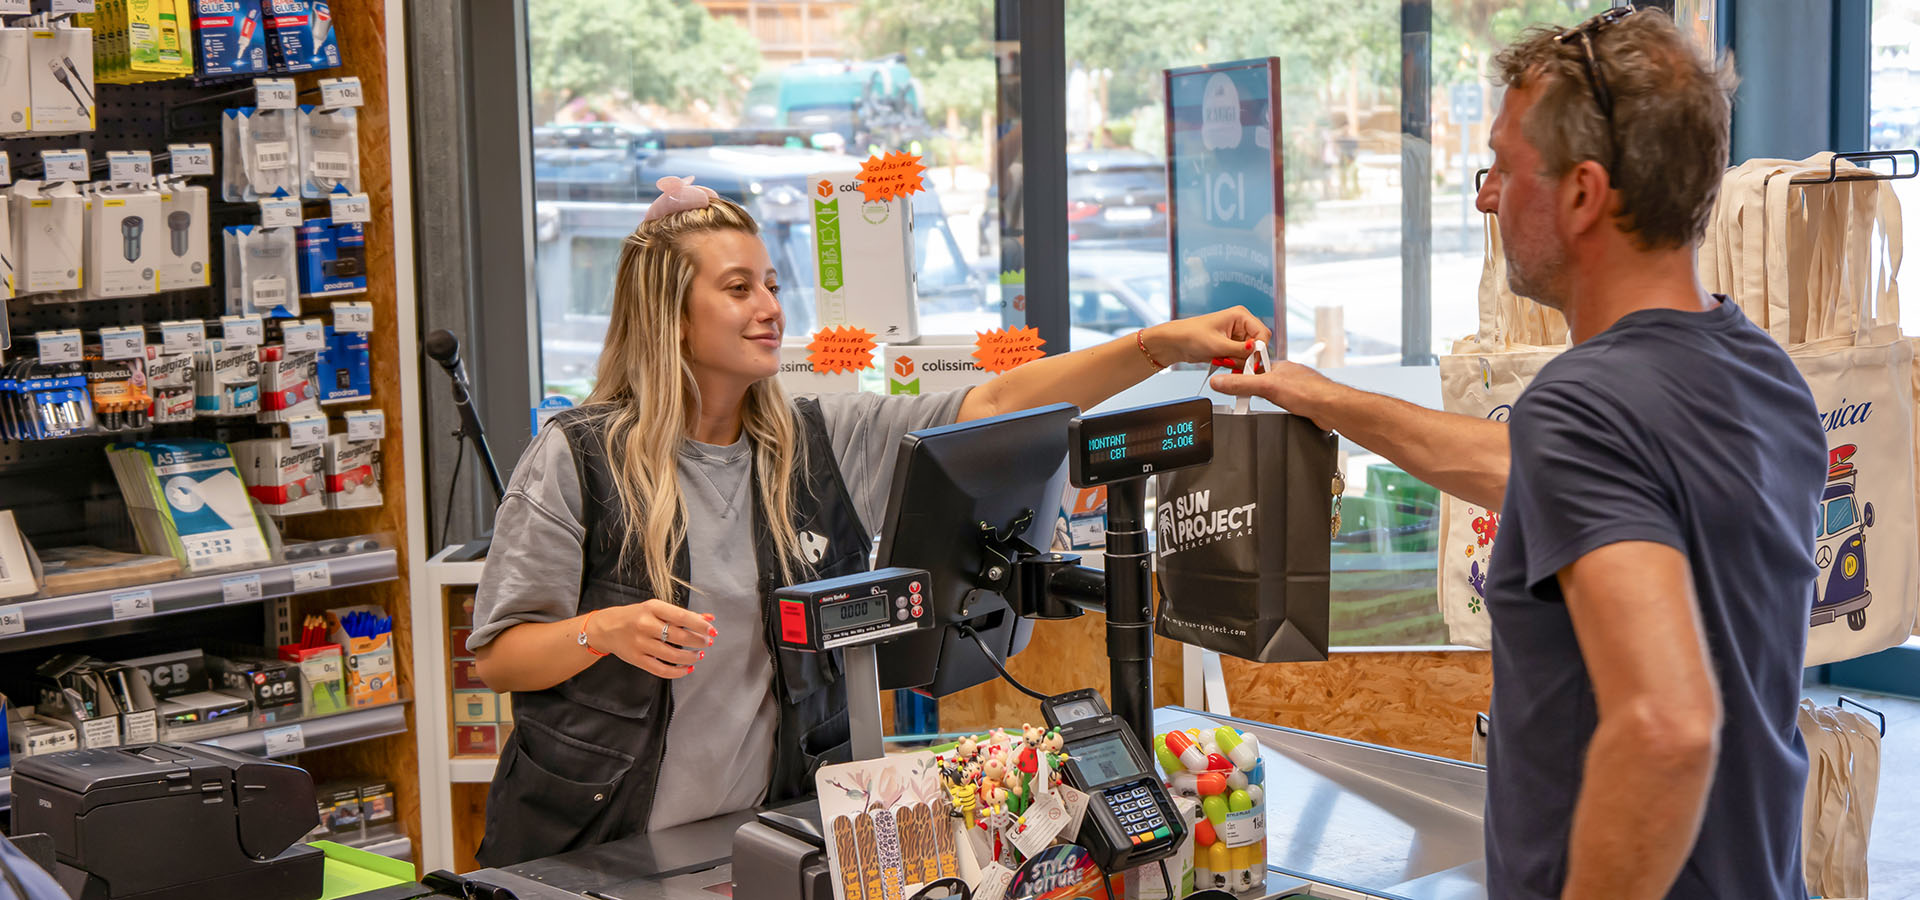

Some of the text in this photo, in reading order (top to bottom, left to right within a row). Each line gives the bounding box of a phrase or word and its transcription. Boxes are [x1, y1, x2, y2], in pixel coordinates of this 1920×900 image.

[1205, 171, 1245, 222] ICI
[323, 281, 354, 291] goodram
[149, 355, 192, 377] Energizer
[215, 350, 257, 371] Energizer
[278, 351, 316, 373] Energizer
[95, 370, 131, 379] DURACELL
[328, 389, 359, 398] goodram
[1089, 421, 1194, 451] MONTANT 0.00€
[157, 452, 174, 465] A5
[280, 447, 321, 468] Energizer
[337, 443, 373, 461] Energizer
[1110, 435, 1194, 460] CBT 25.00€
[1176, 490, 1210, 519] SUN
[1178, 503, 1256, 543] PROJECT
[1180, 528, 1253, 552] BEACHWEAR
[260, 681, 296, 698] OCB
[1031, 854, 1077, 879] STYLO
